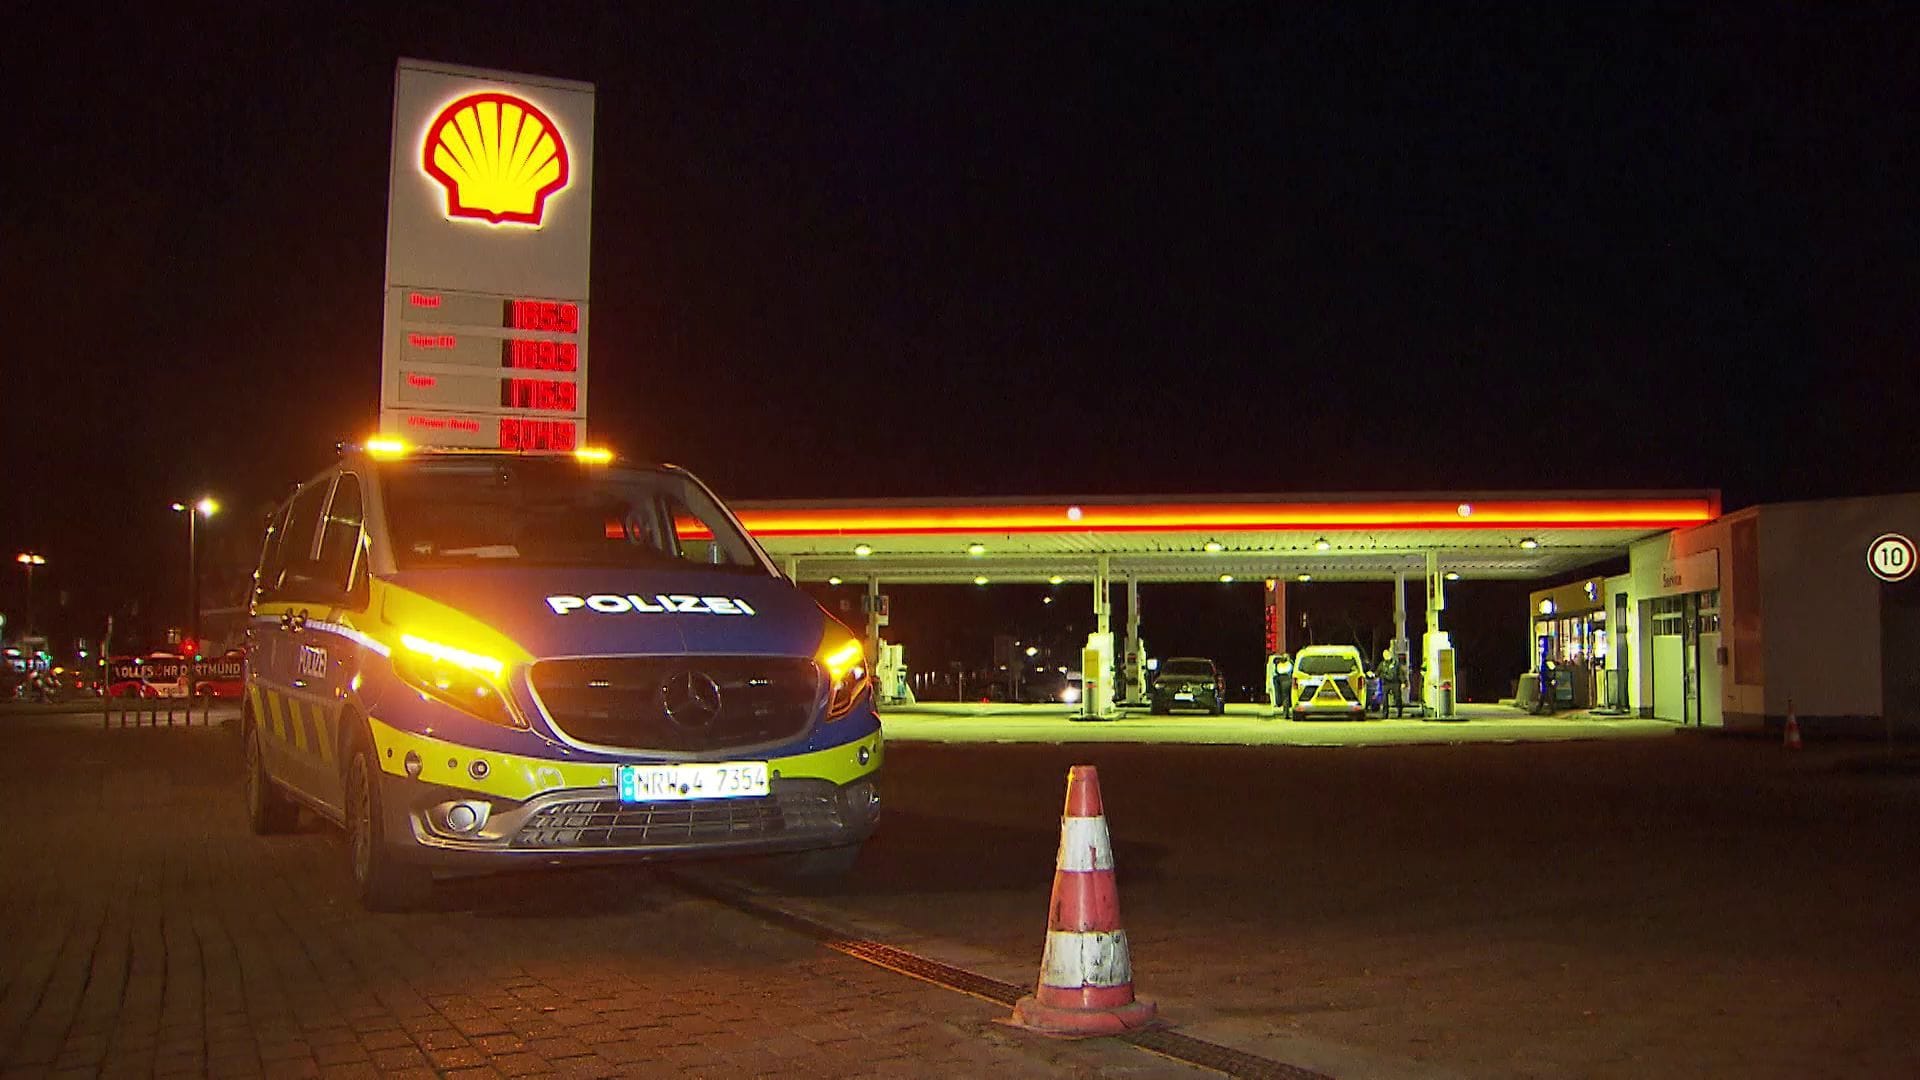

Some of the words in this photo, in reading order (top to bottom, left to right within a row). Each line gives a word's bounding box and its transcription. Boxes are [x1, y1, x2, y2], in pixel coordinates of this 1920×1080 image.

[1881, 547, 1903, 566] 10
[546, 594, 756, 616] POLIZEI
[717, 768, 765, 792] 7354
